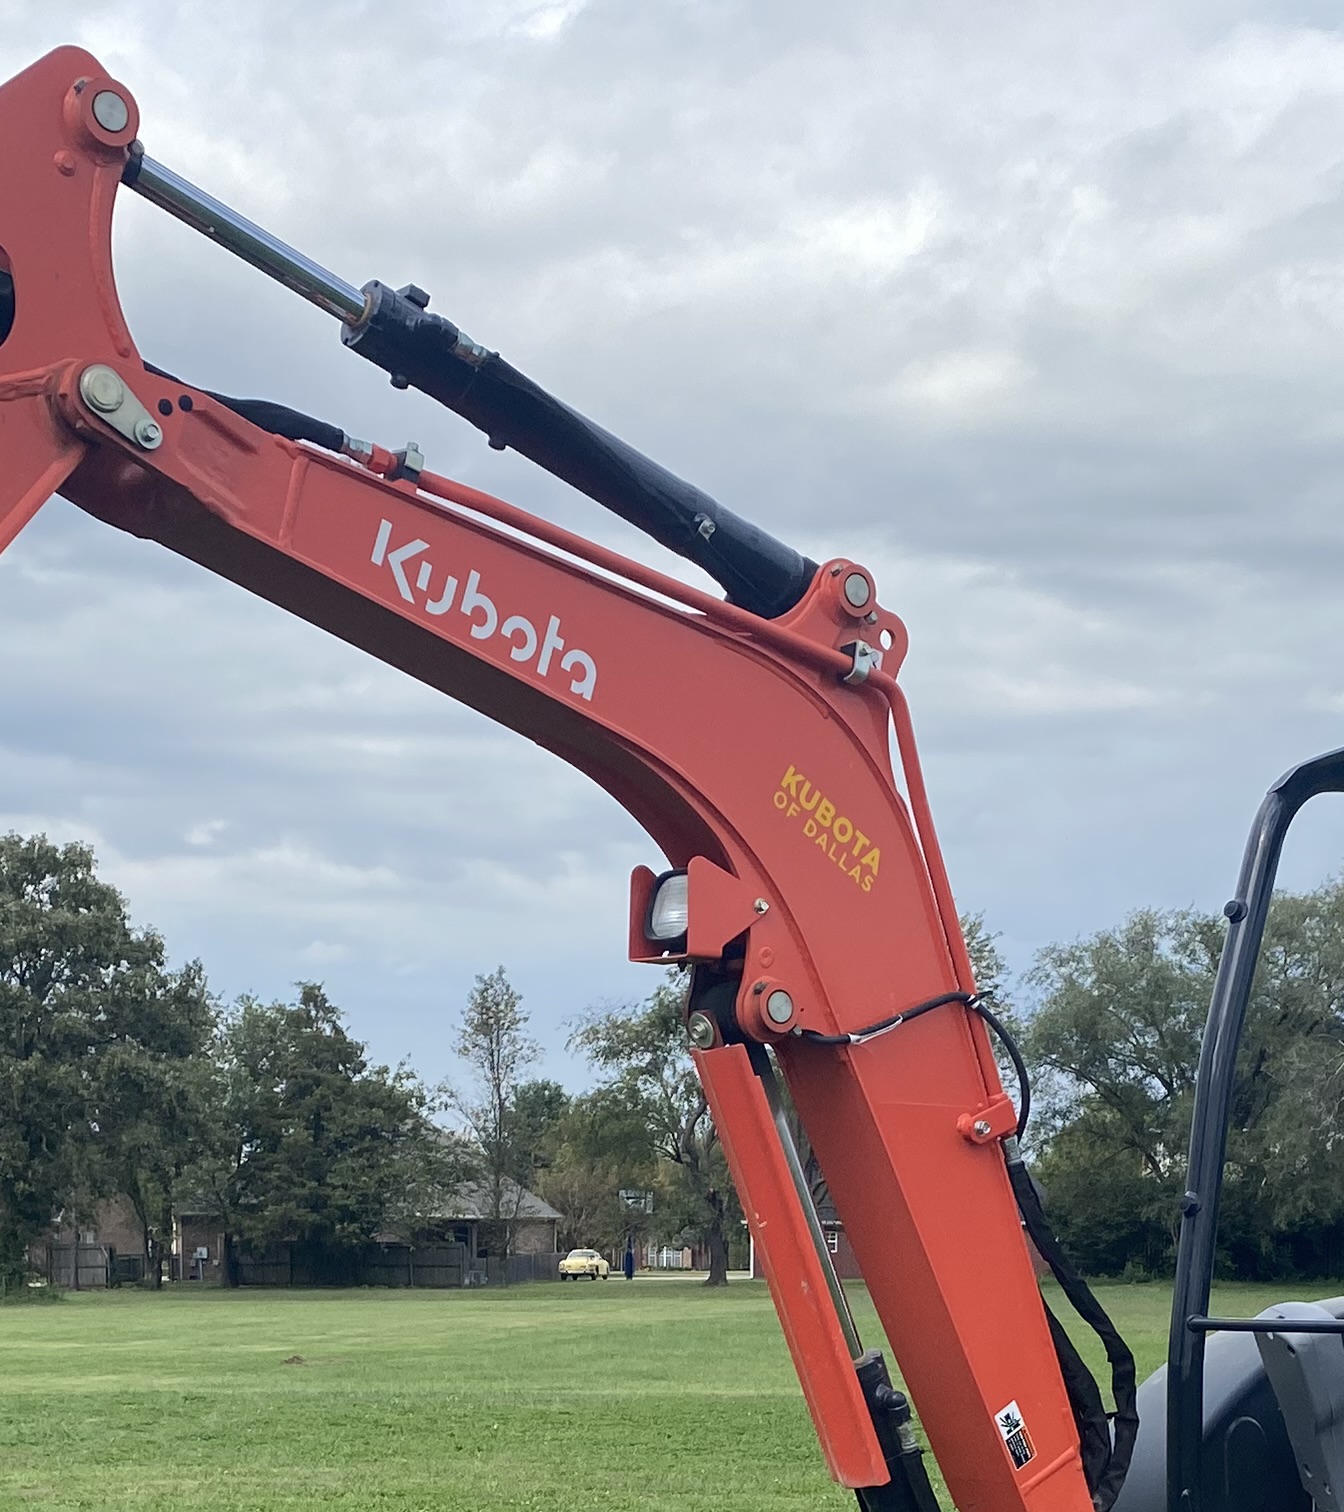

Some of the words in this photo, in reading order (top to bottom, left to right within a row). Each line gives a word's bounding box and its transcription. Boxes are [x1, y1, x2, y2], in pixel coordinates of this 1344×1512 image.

[371, 518, 597, 701] Kubota
[773, 790, 801, 817] OF
[802, 818, 875, 892] DALLAS
[780, 765, 881, 877] KUBOTA
